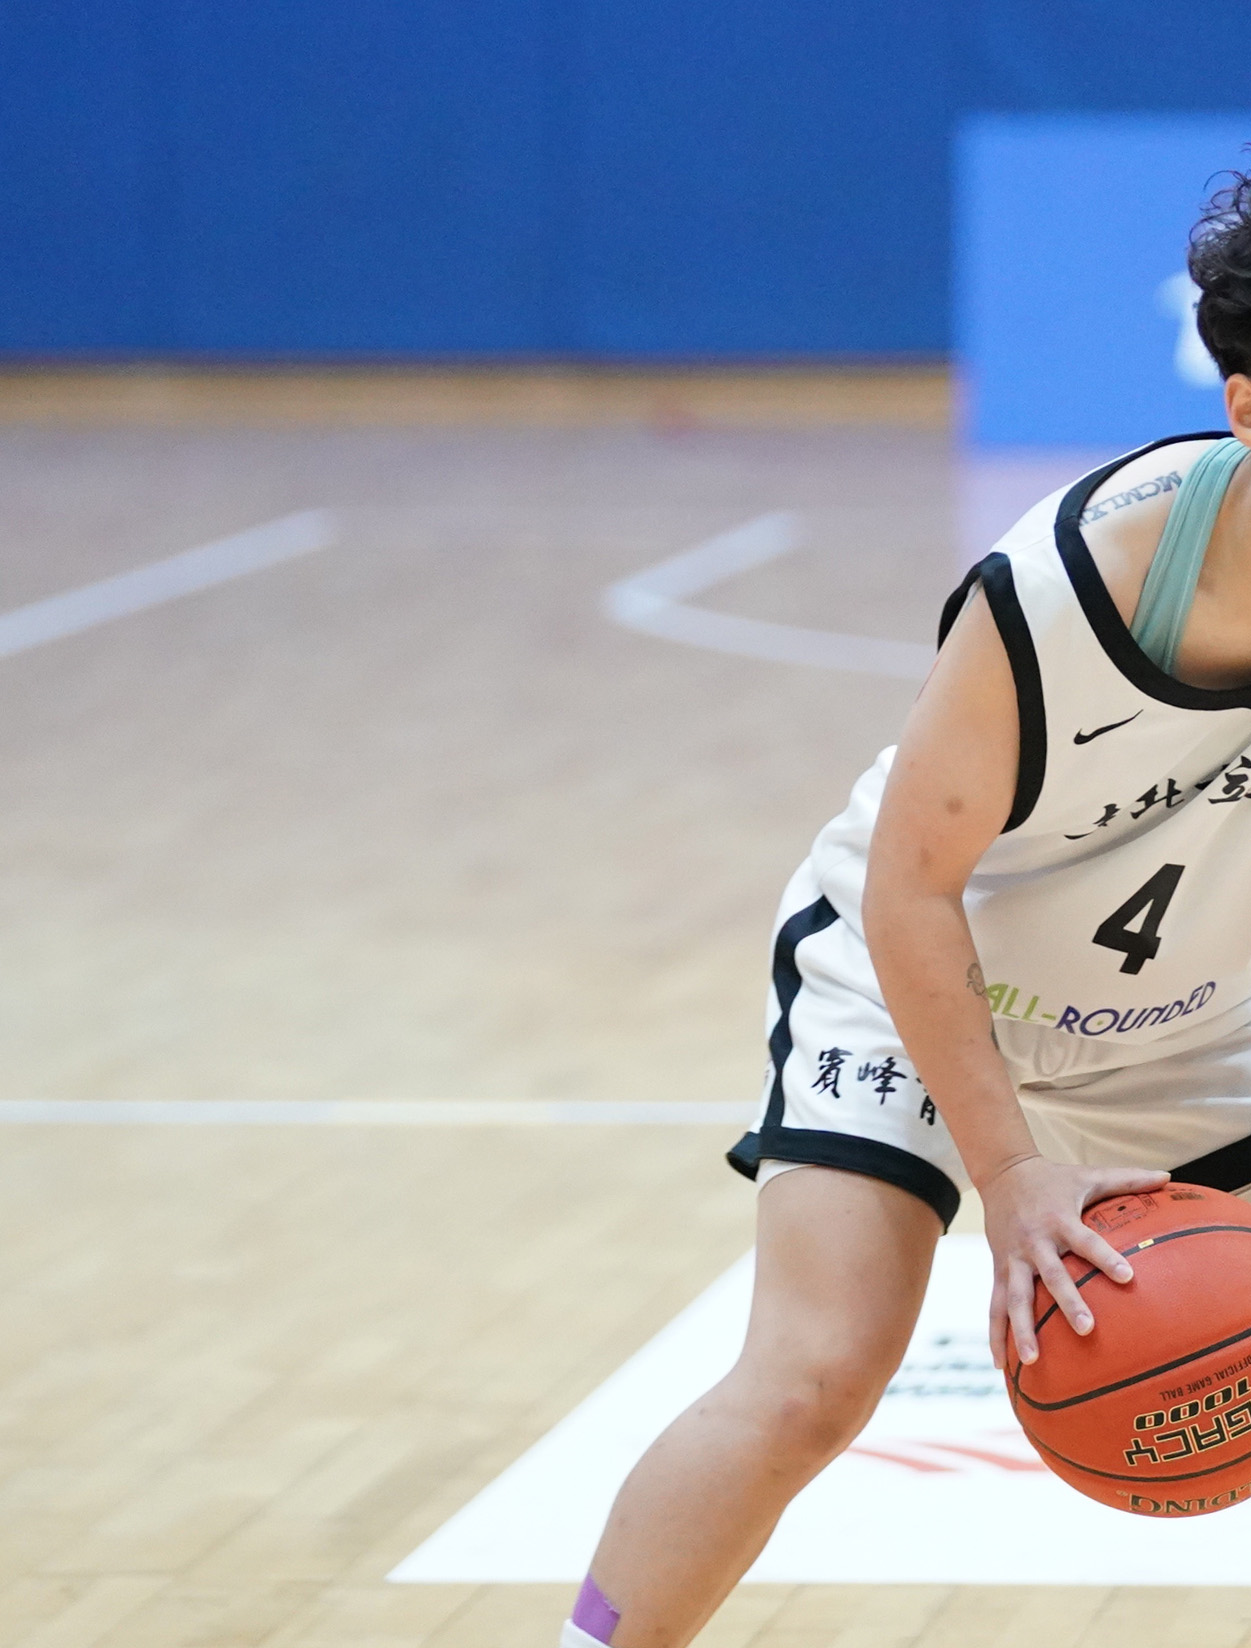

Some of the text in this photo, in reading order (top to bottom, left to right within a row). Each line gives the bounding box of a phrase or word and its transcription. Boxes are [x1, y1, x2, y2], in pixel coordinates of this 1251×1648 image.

[1092, 863, 1185, 975] 4
[986, 981, 1217, 1036] ALL-ROUNDED
[1133, 1377, 1251, 1431] 1000
[1159, 1385, 1183, 1401] BALL
[1185, 1375, 1212, 1393] GAME
